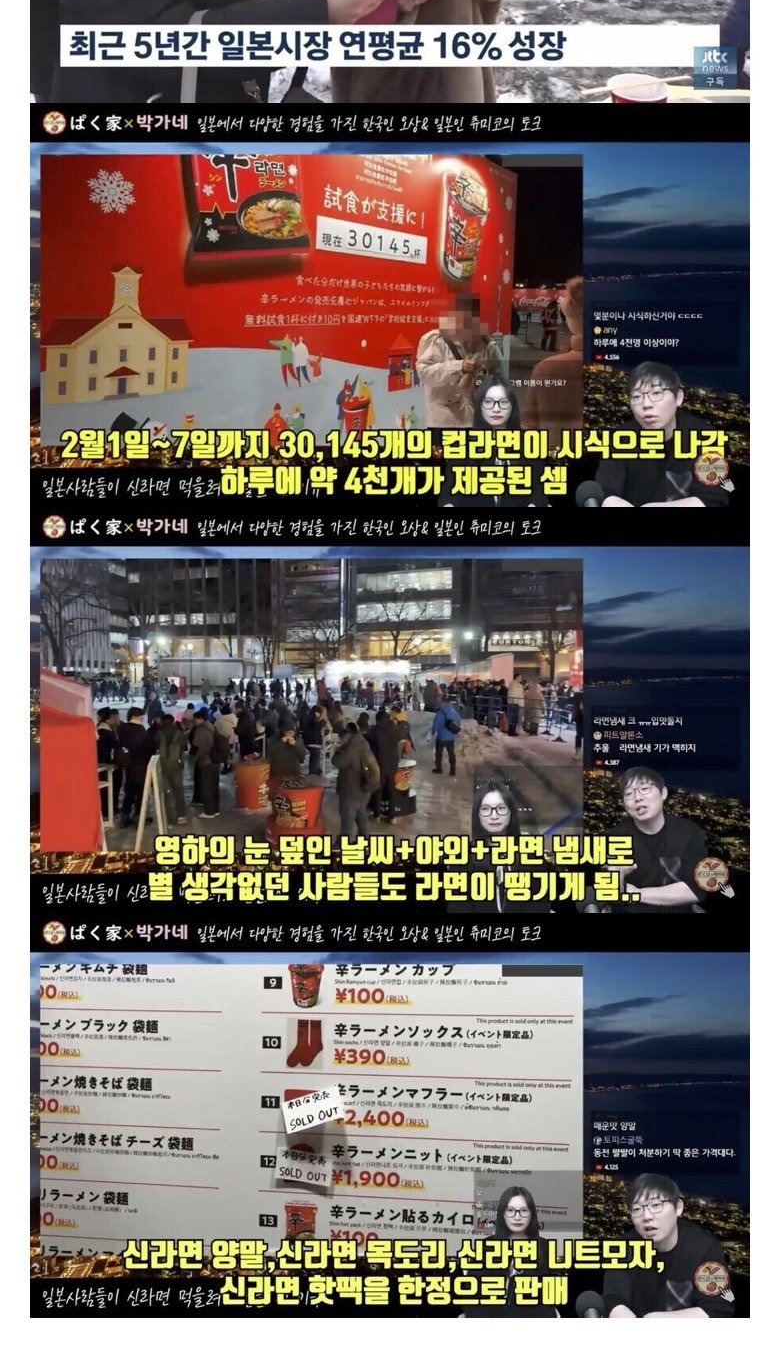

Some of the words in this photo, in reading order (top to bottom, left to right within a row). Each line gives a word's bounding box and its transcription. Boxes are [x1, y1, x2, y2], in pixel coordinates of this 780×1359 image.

[255, 161, 285, 177] 라면
[259, 177, 285, 188] ラーメン
[322, 233, 342, 248] 現在
[348, 229, 410, 255] 30145
[336, 965, 407, 977] 辛ラーメン
[269, 978, 277, 987] 9
[336, 988, 385, 1003] ¥100
[81, 1020, 128, 1032] ブラック
[132, 1020, 159, 1033] 袋麺
[264, 1037, 279, 1048] 10
[334, 1048, 386, 1065] ¥390
[289, 1116, 315, 1131] SOLD
[319, 1107, 339, 1121] OUT
[126, 1136, 164, 1151] チーズ
[167, 1137, 194, 1151] 袋麺
[332, 1169, 400, 1188] ¥1,900
[262, 1216, 274, 1226] 13
